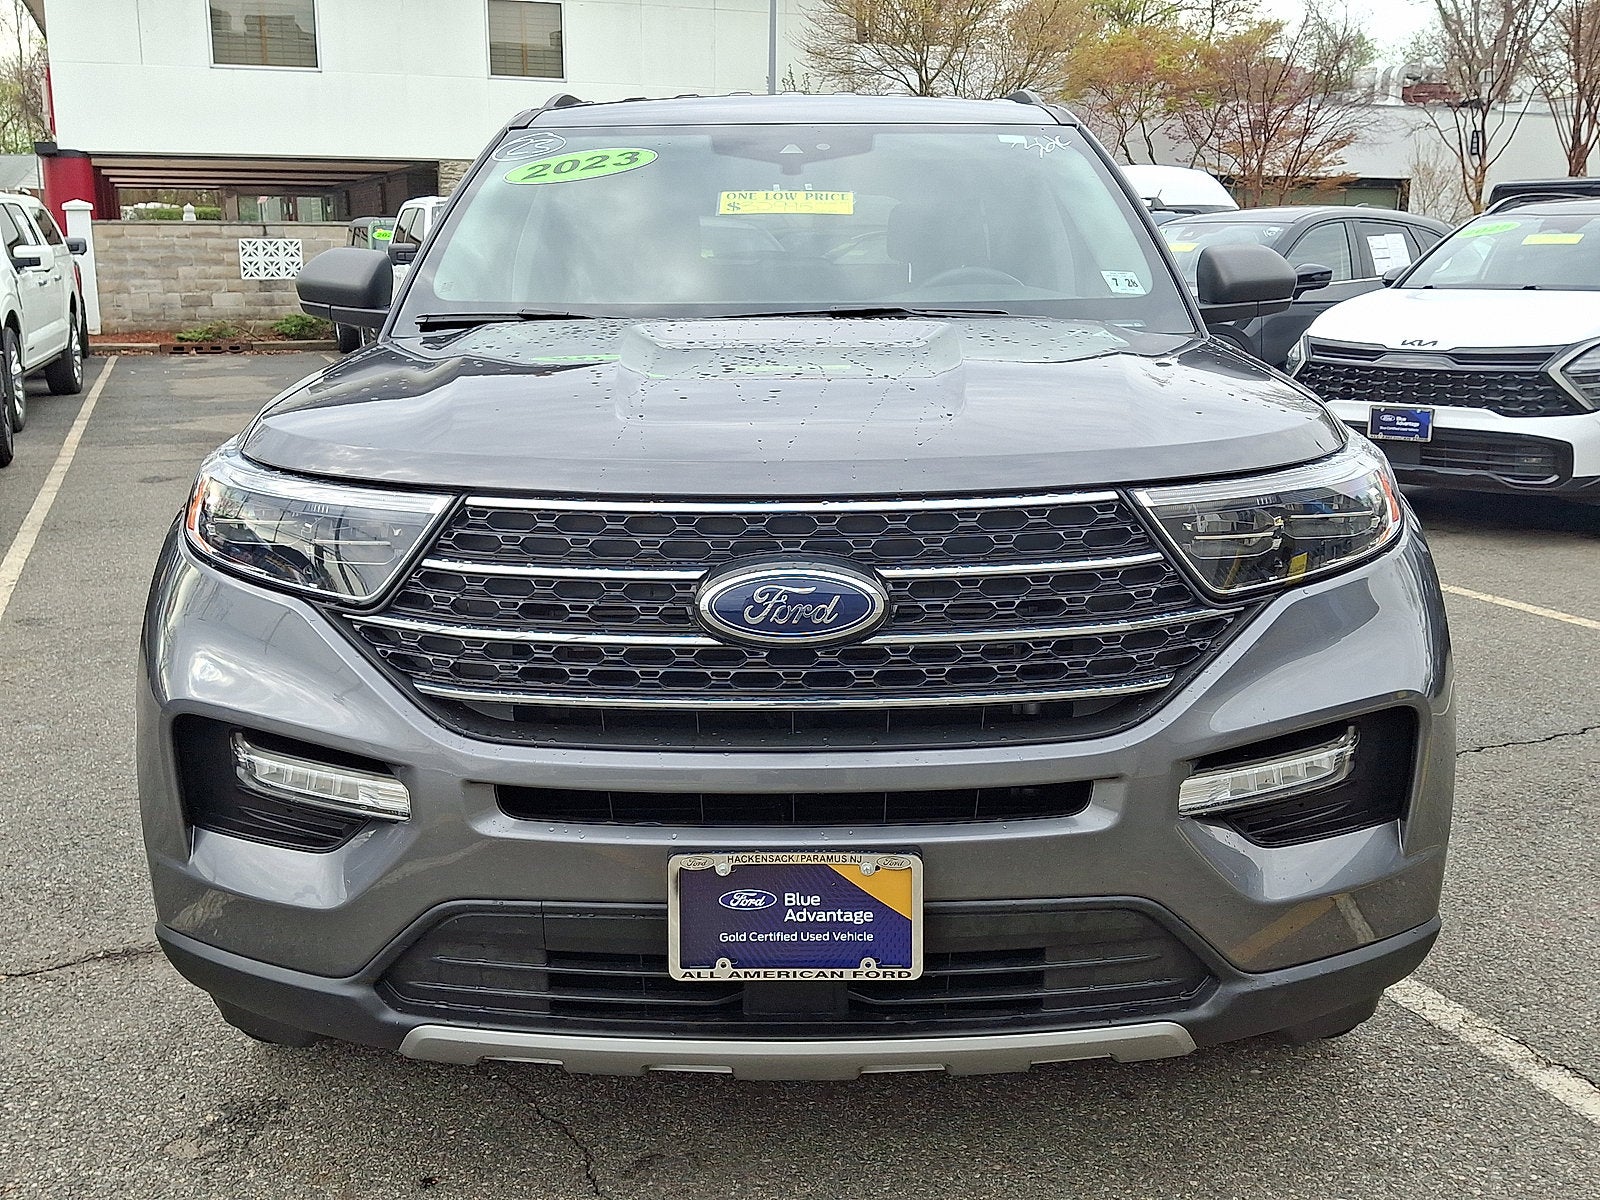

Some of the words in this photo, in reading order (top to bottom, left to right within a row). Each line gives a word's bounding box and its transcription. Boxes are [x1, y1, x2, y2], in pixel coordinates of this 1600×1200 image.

[521, 151, 641, 181] 2023
[727, 192, 757, 200] ONE
[765, 192, 797, 200] LOW
[805, 192, 849, 200] PRICE
[1112, 278, 1119, 286] 7
[743, 584, 841, 624] Ford
[850, 855, 862, 864] NJ
[729, 892, 766, 907] Ford
[784, 892, 821, 906] Blue
[784, 908, 874, 925] Advantage
[719, 931, 747, 942] Gold
[749, 931, 798, 942] Certified
[800, 931, 830, 942] Used
[832, 931, 874, 942] Vehicle
[681, 971, 722, 979] ALL
[728, 971, 844, 979] AMERICAN
[852, 971, 912, 979] FORD
